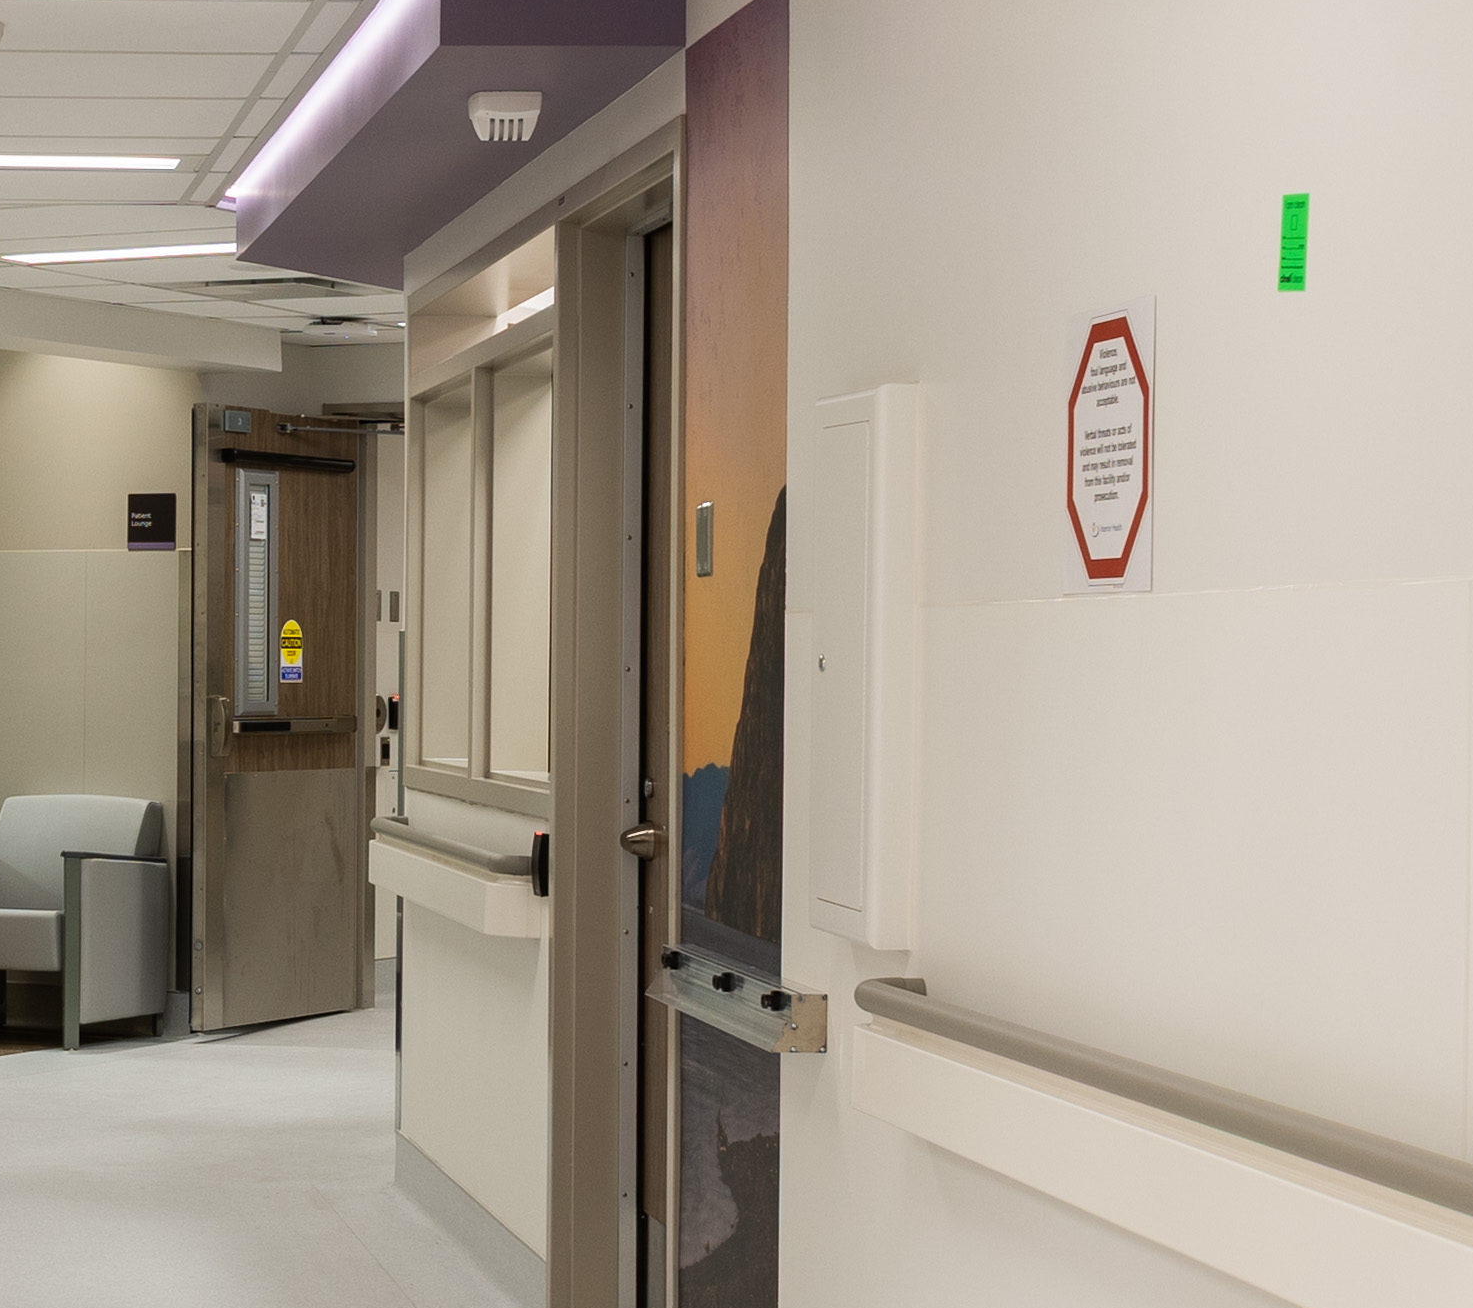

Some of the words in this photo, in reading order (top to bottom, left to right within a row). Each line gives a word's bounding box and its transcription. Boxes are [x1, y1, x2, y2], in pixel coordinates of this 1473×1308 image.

[1099, 363, 1118, 376] language
[1118, 361, 1127, 371] and
[131, 512, 152, 520] Patient
[131, 520, 152, 528] Lounge
